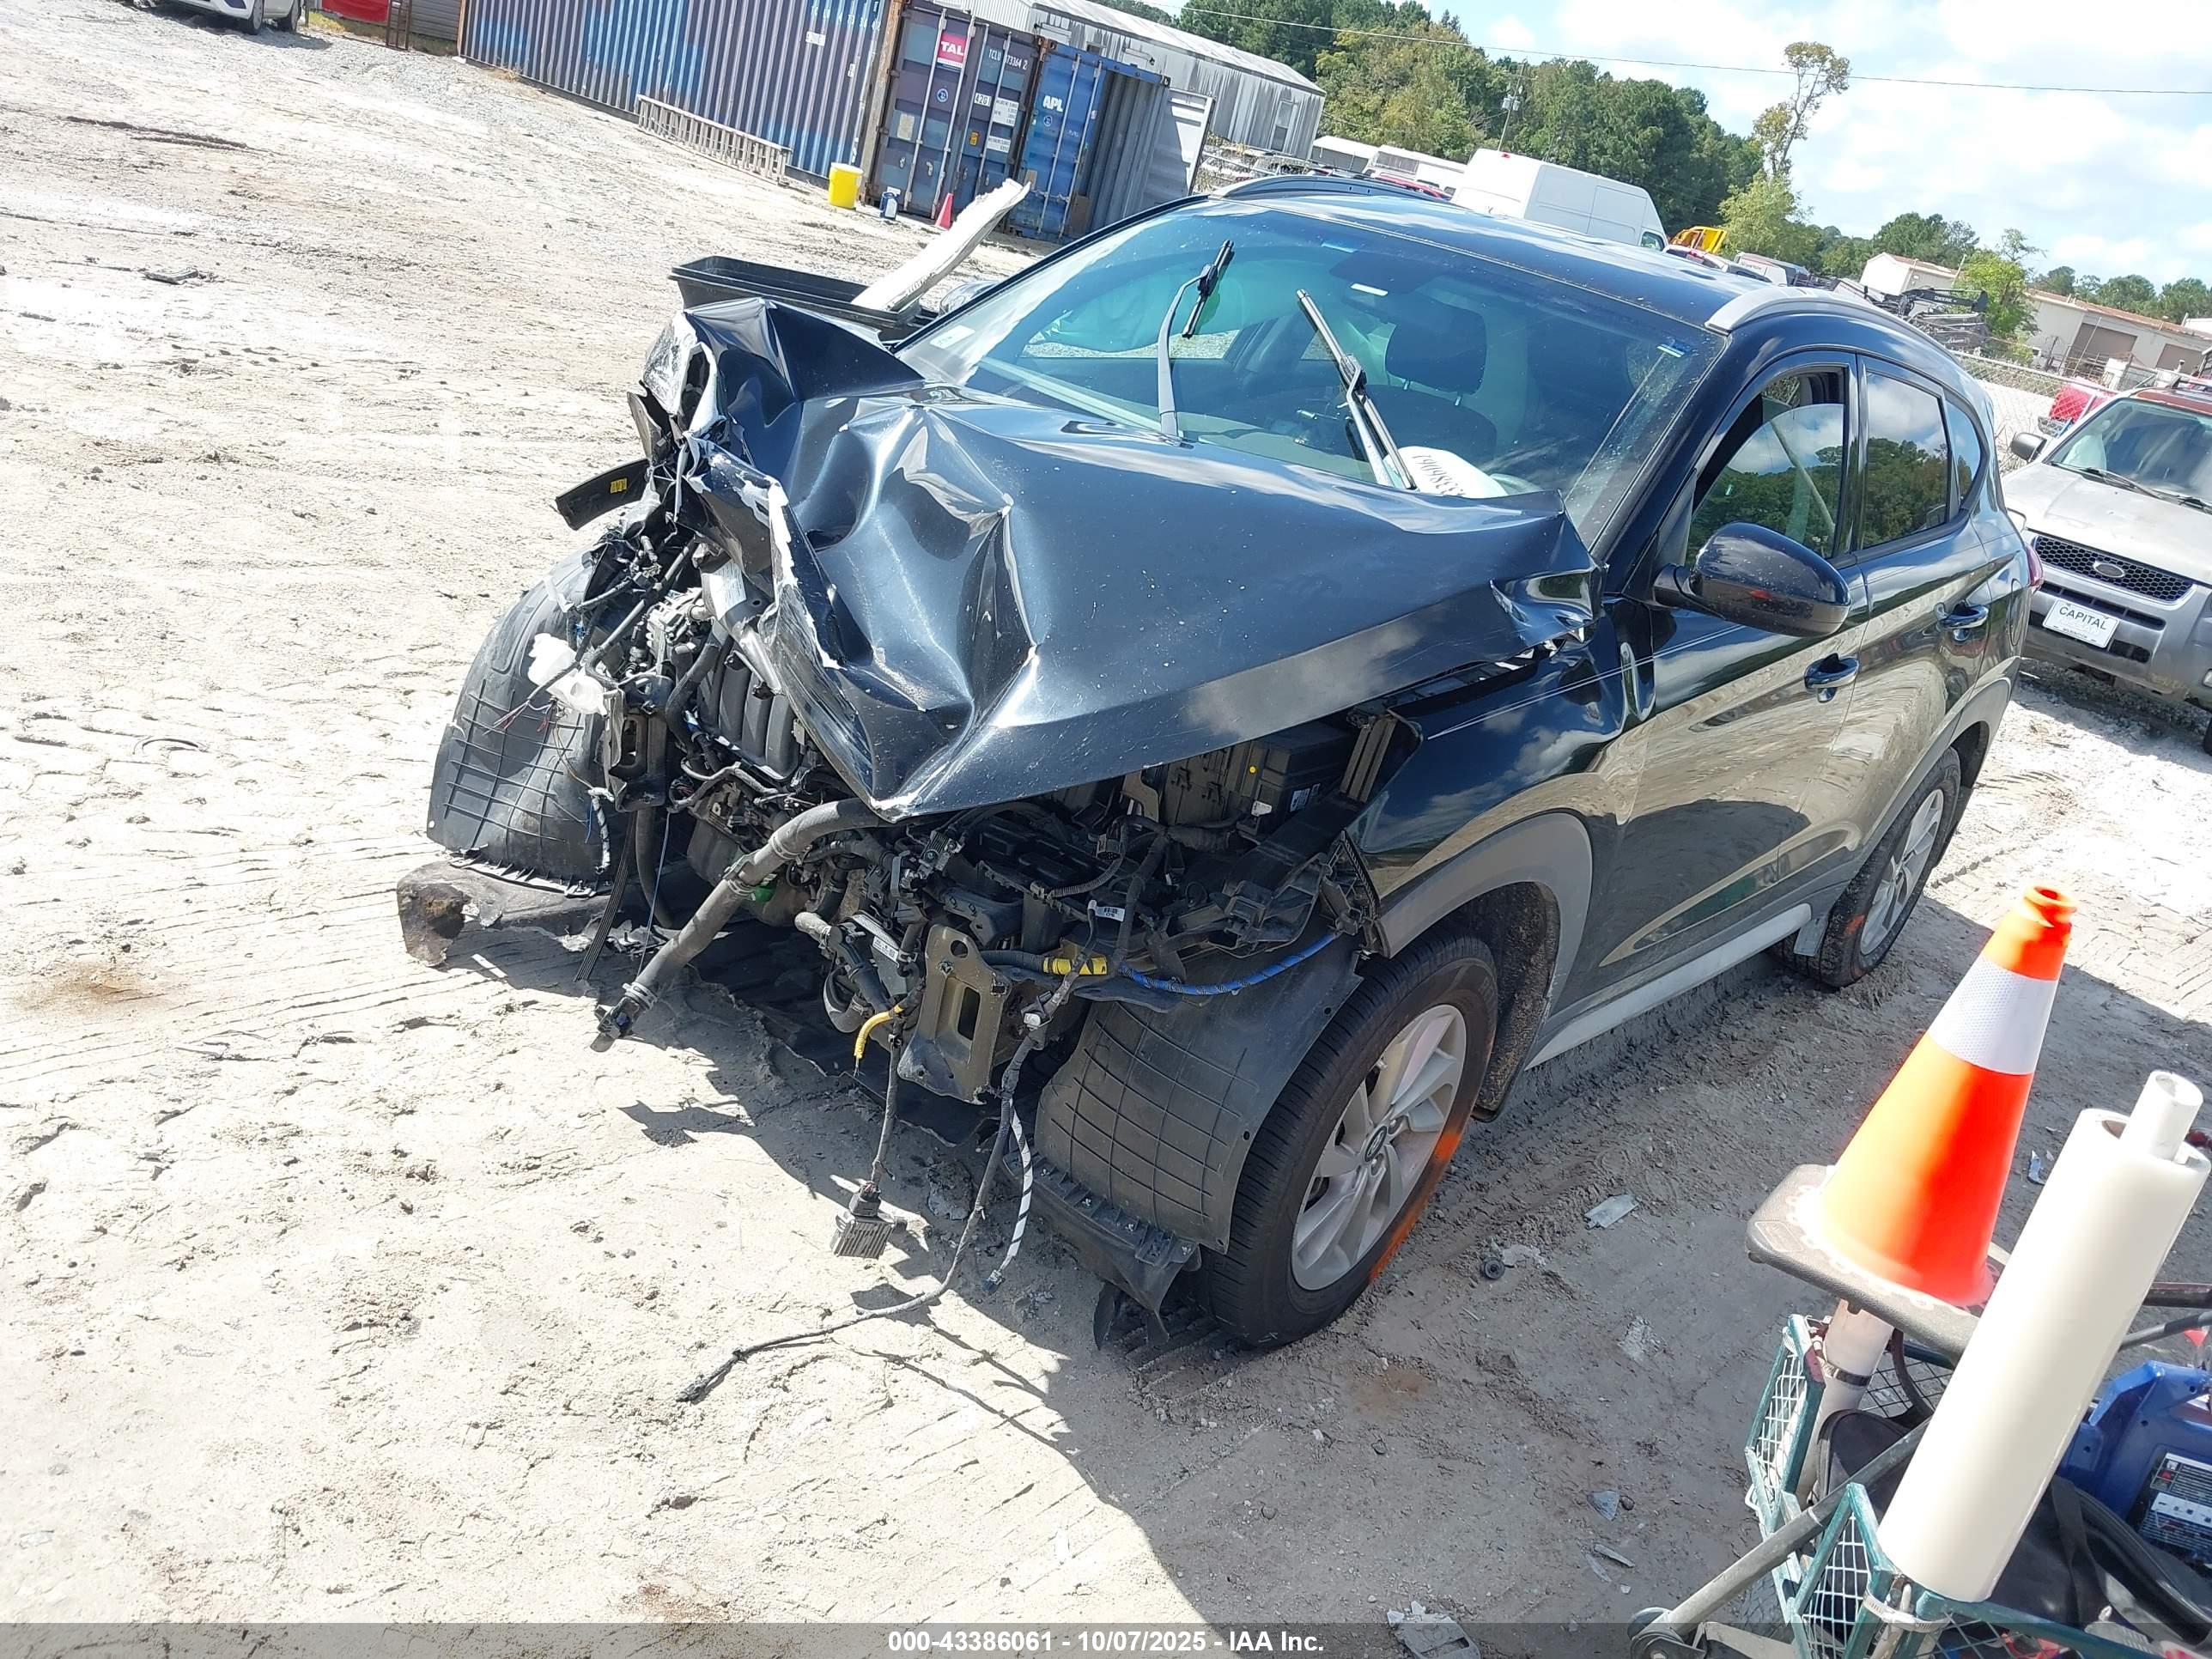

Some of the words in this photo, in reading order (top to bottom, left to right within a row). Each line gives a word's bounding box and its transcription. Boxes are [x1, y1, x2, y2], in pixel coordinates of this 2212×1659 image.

[940, 40, 964, 56] TAL
[1022, 59, 1029, 70] 2
[1042, 94, 1064, 112] APL
[2059, 606, 2106, 630] CAPITAL
